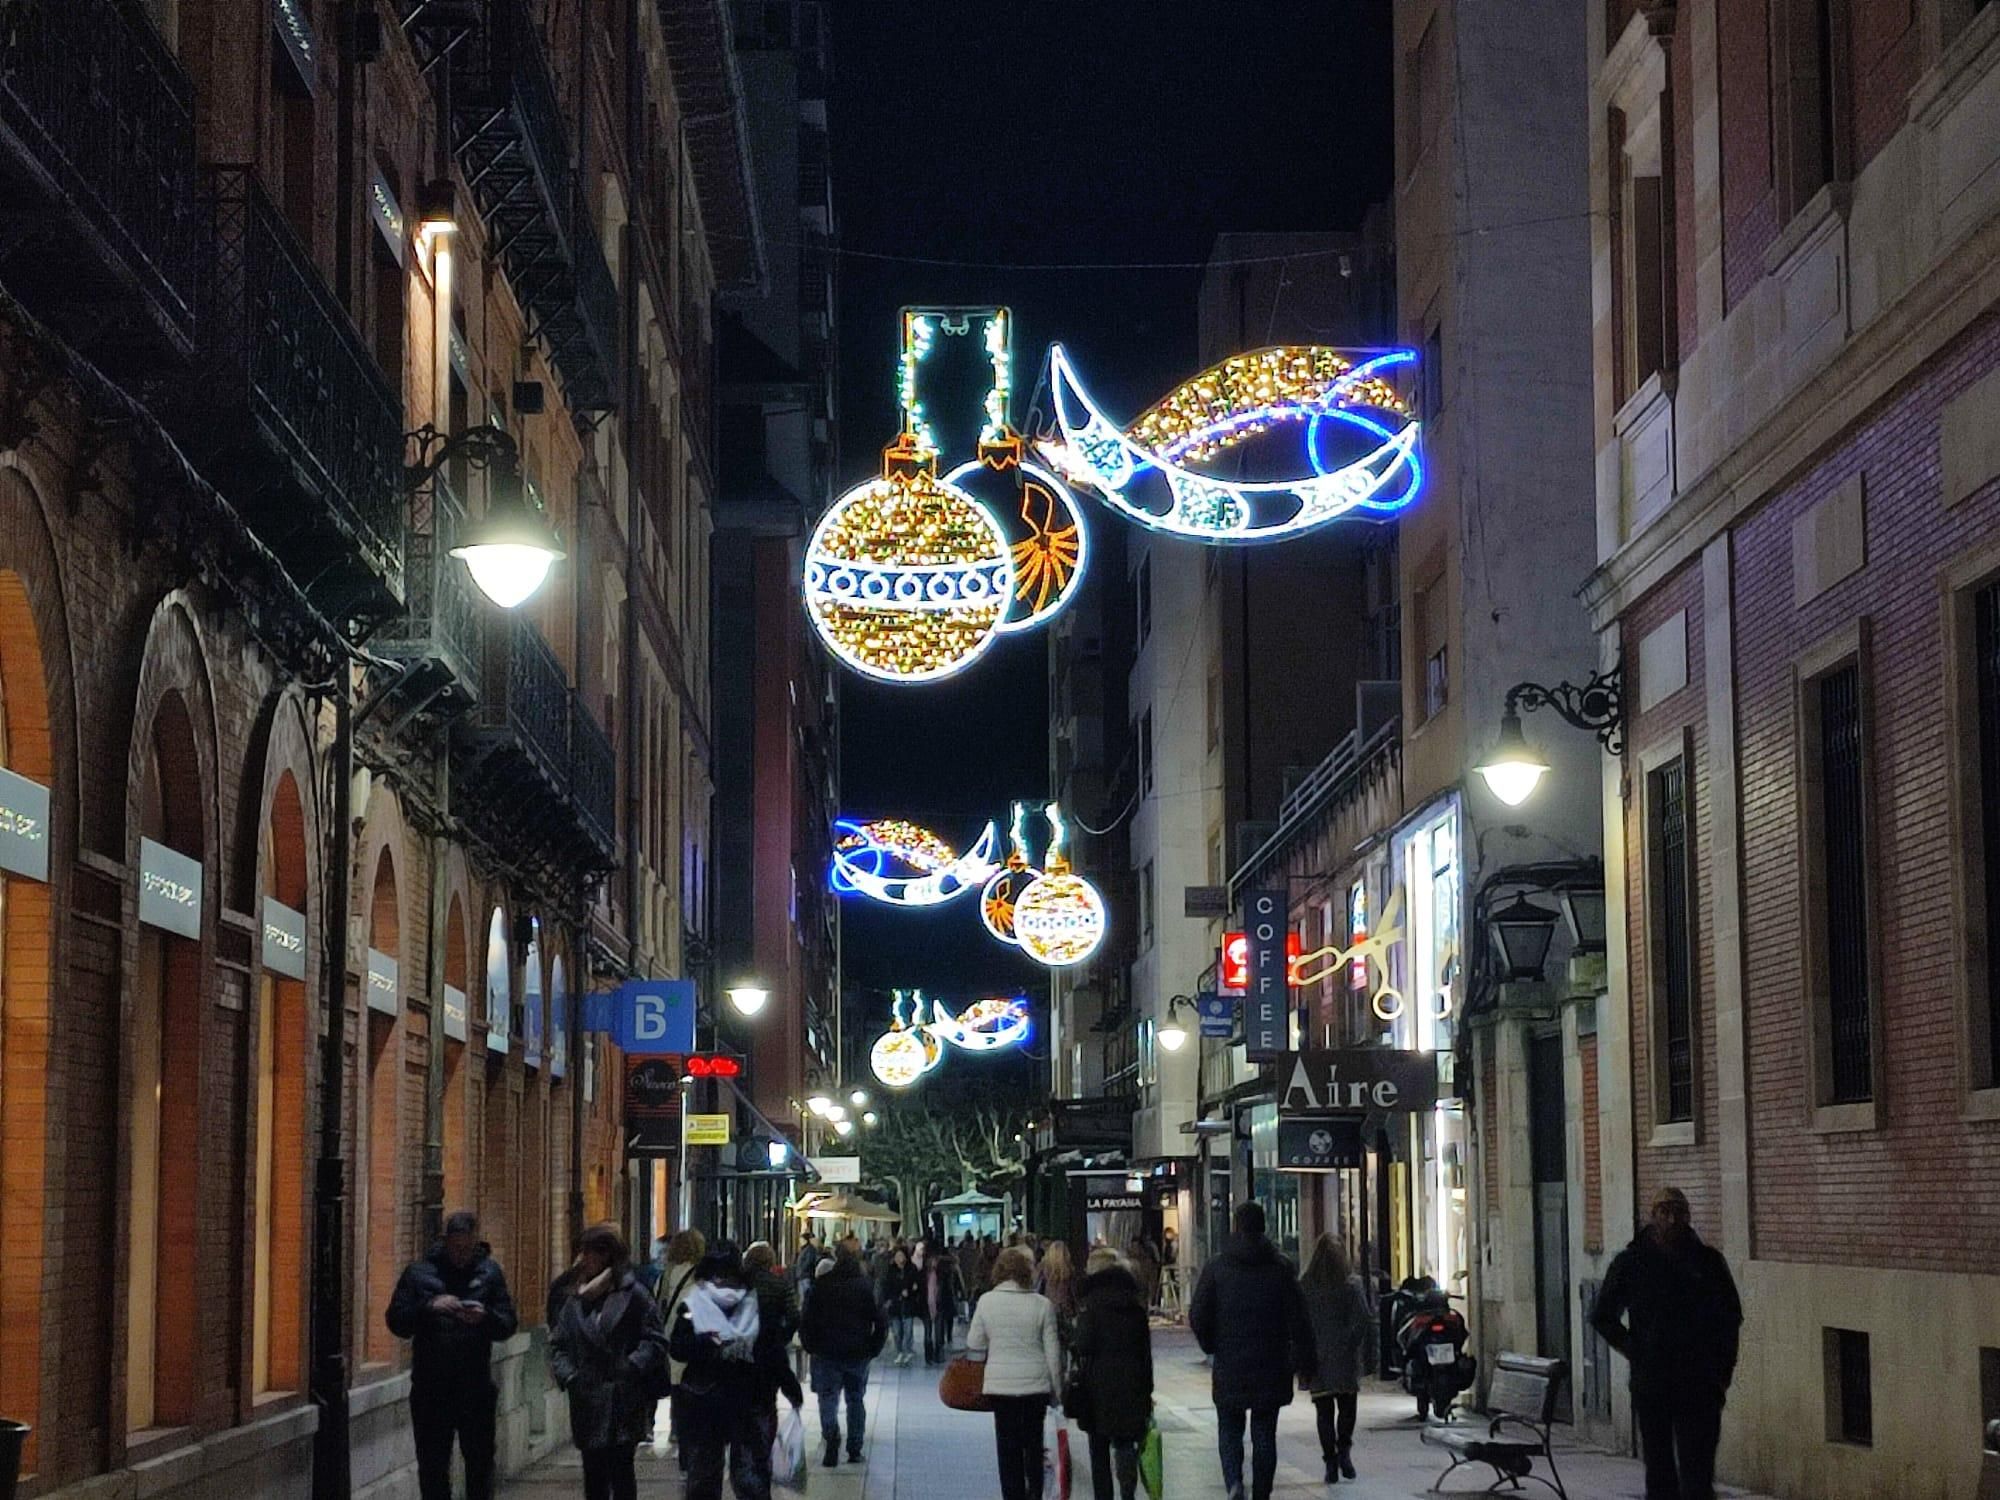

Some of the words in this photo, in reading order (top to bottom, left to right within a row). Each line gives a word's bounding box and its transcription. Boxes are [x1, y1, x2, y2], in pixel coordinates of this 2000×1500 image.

[1256, 896, 1274, 1049] COFFEE
[635, 994, 667, 1040] B
[1279, 1055, 1399, 1110] Aire
[1291, 1155, 1351, 1165] COFFEE
[1086, 1198, 1101, 1209] LA
